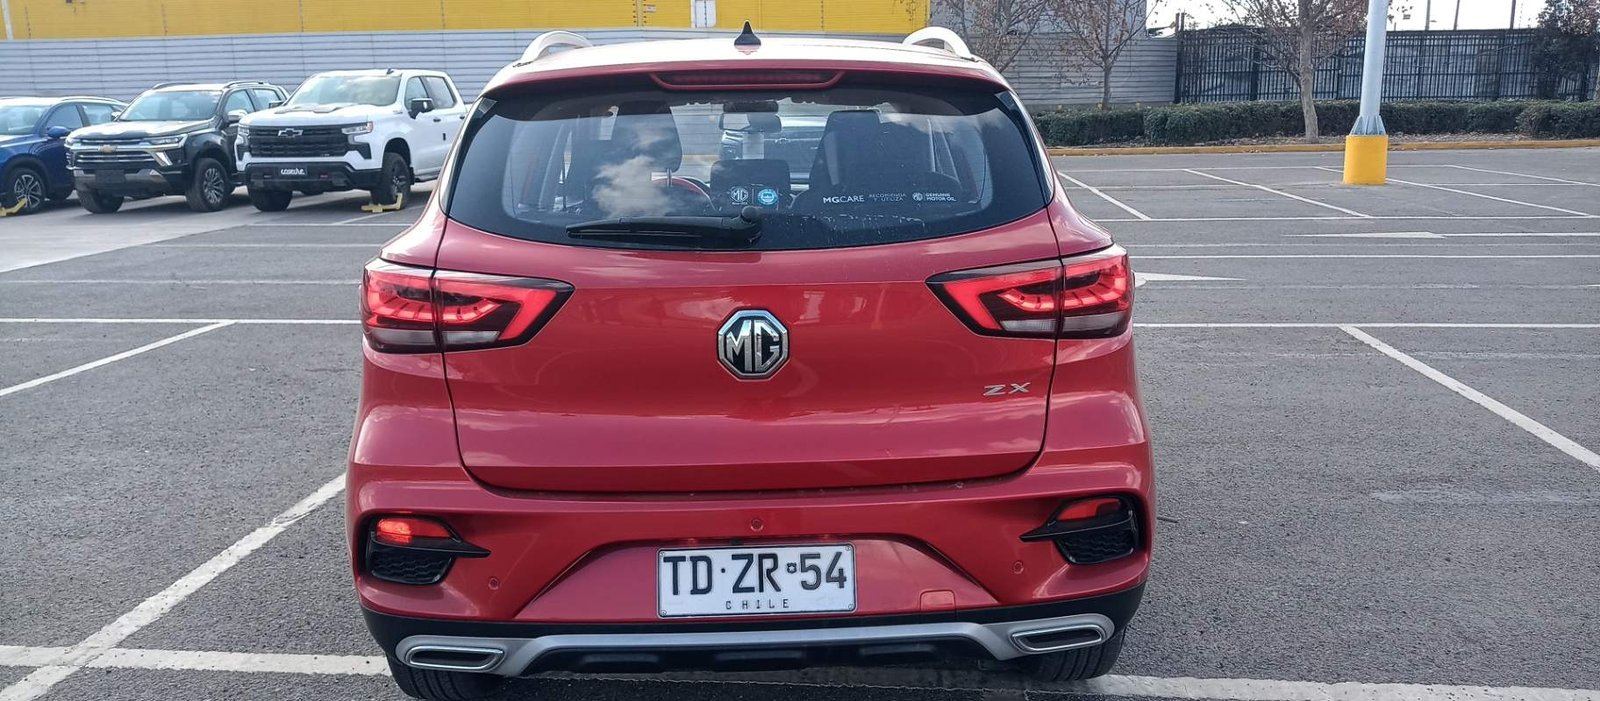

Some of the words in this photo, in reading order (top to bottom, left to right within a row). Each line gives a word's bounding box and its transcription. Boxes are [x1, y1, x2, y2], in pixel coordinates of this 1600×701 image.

[725, 318, 781, 373] MG
[982, 381, 1032, 397] ZX
[724, 598, 790, 610] CHILE
